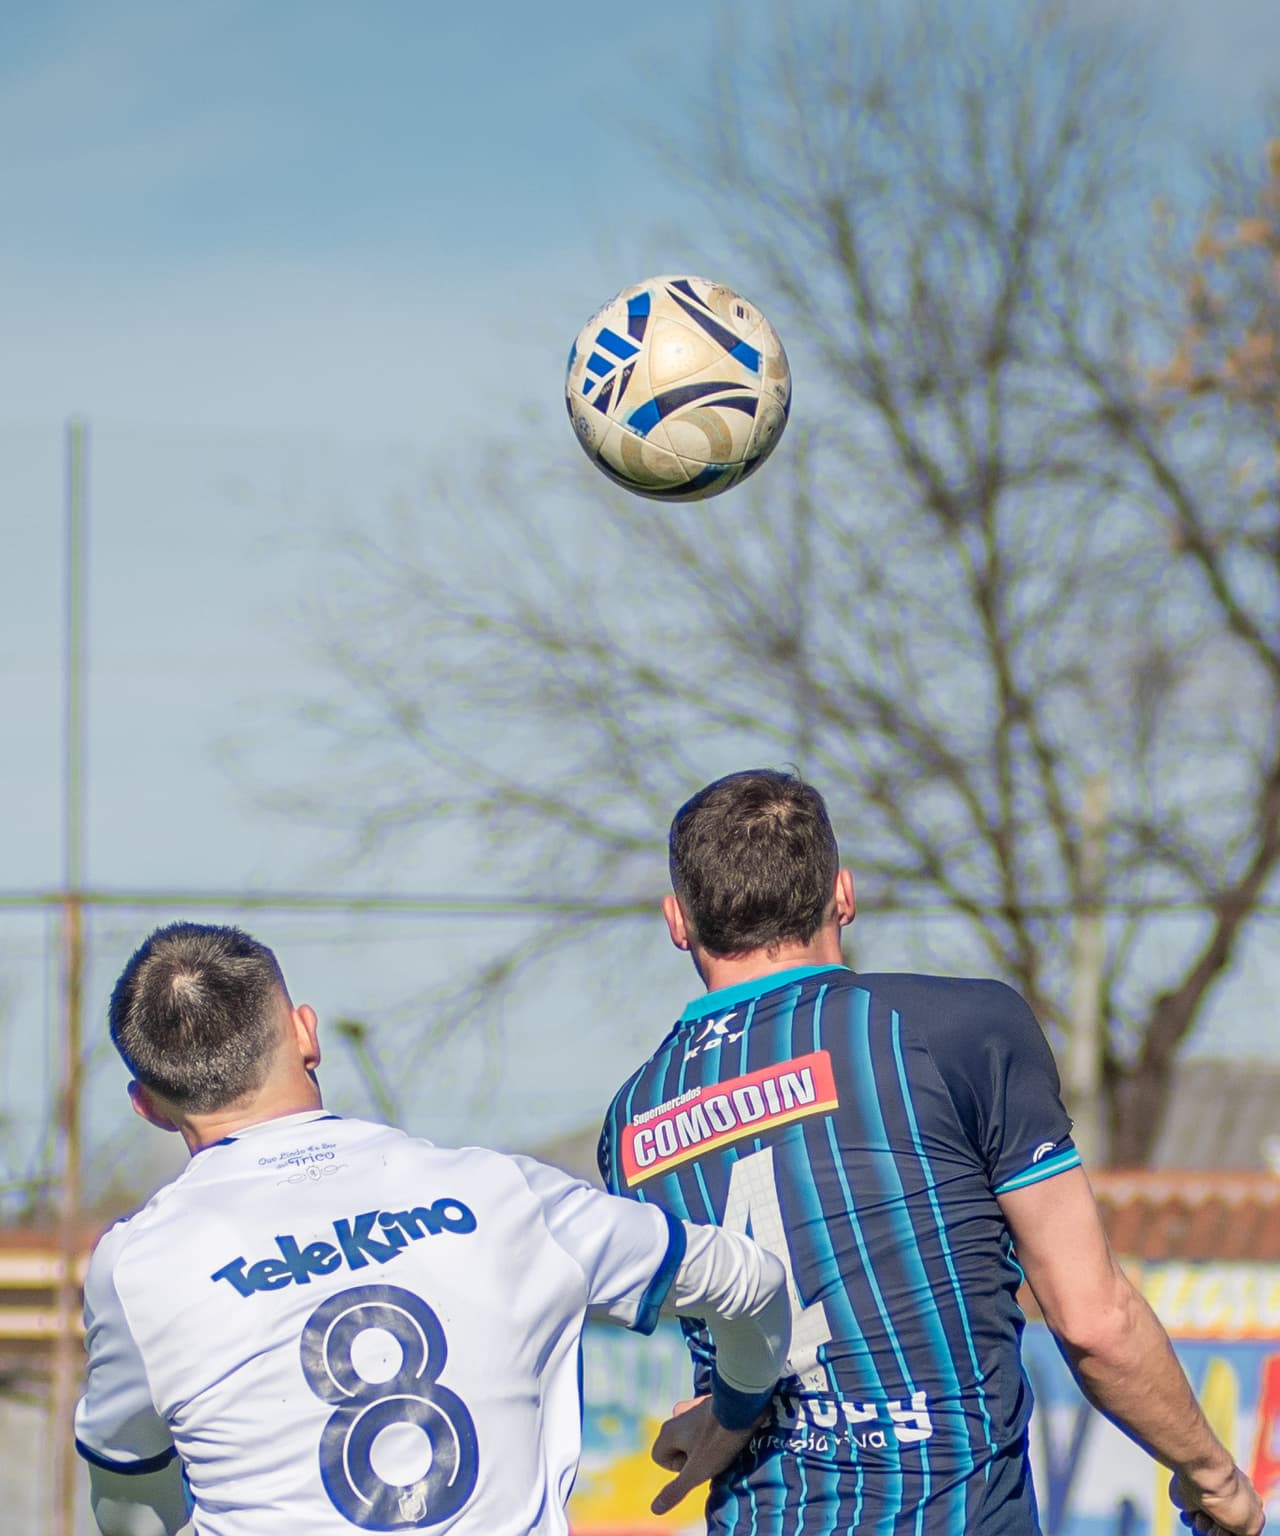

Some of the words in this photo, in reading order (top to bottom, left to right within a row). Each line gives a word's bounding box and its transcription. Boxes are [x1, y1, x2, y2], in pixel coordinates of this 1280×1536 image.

[632, 1086, 703, 1127] Supermercados
[632, 1066, 818, 1169] COMODIN
[210, 1197, 477, 1298] TeleKino
[720, 1146, 832, 1393] 4
[299, 1284, 480, 1532] 8
